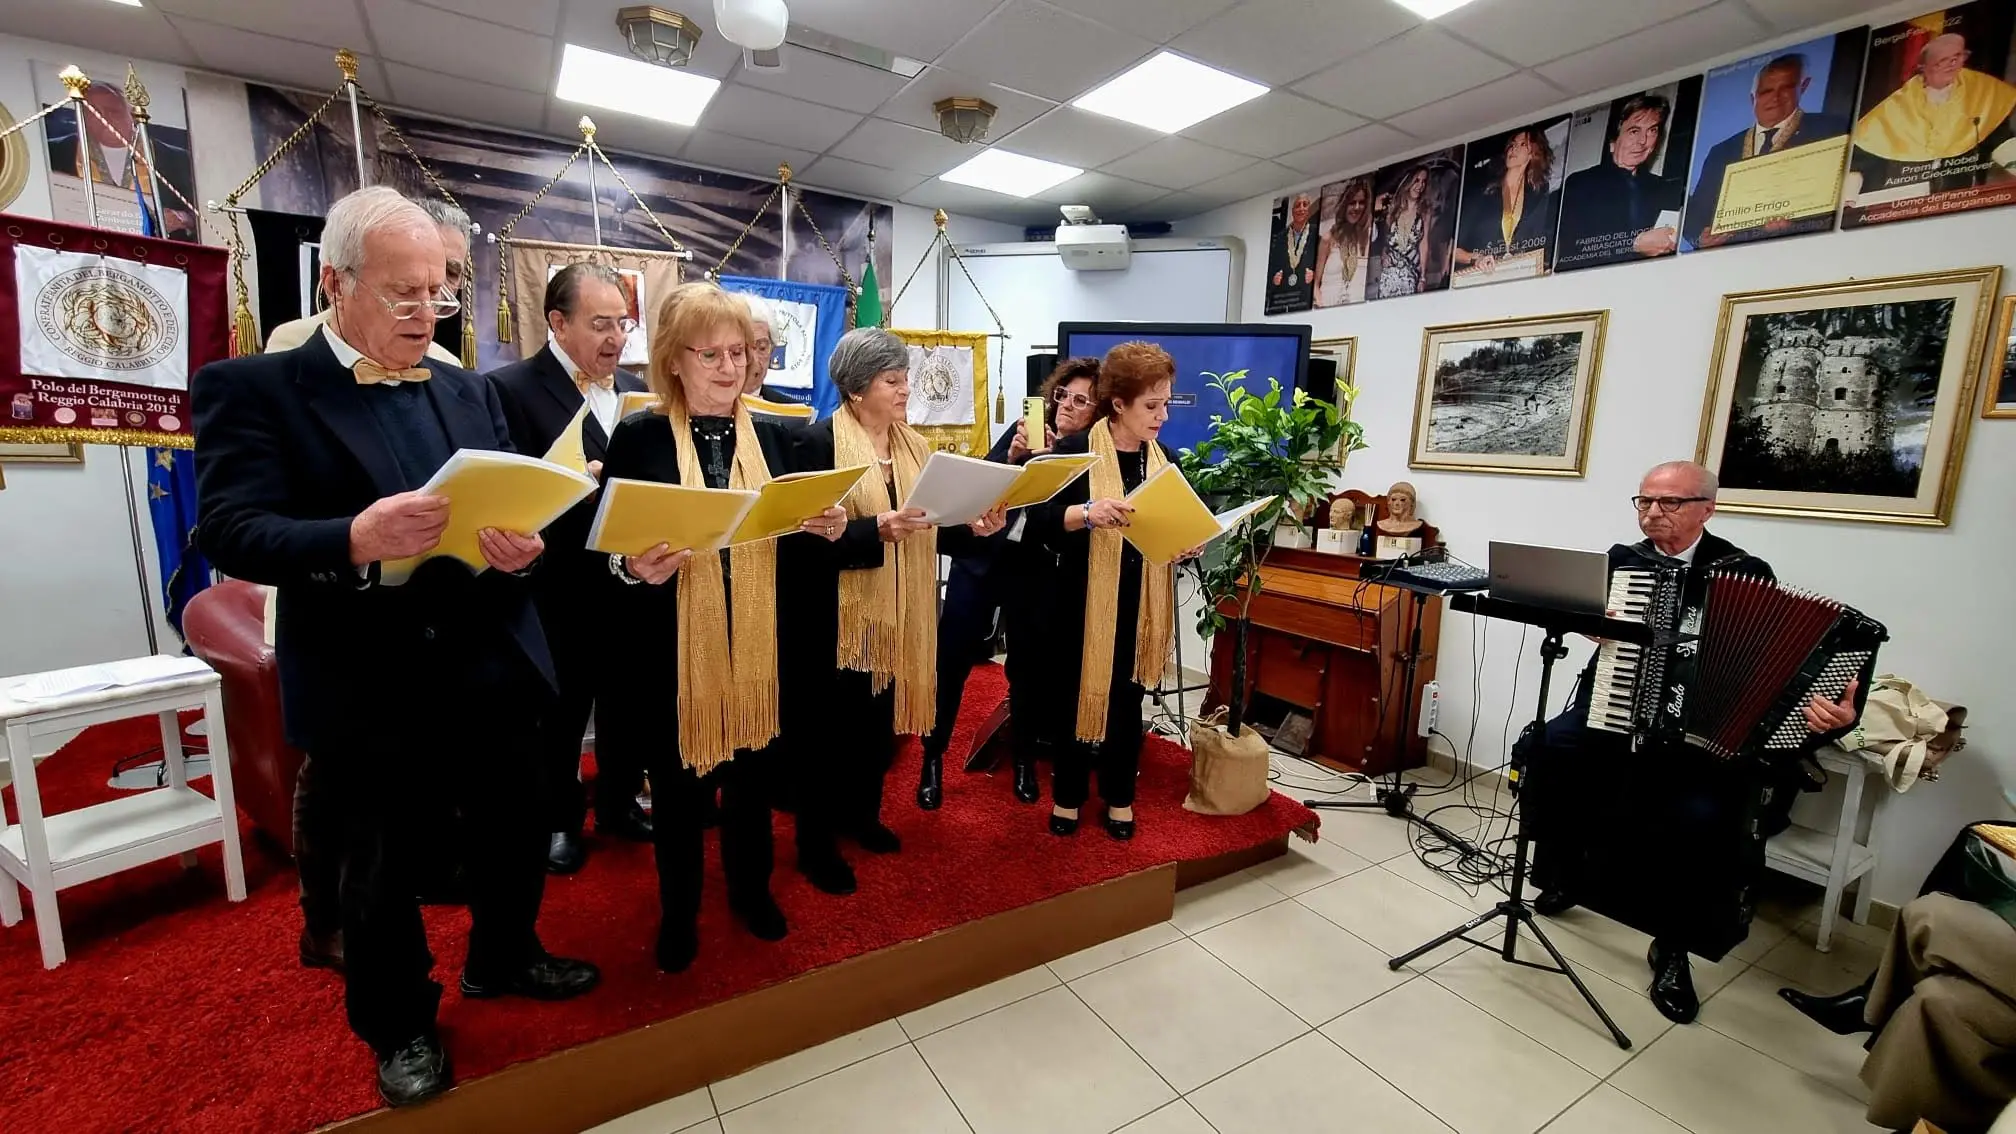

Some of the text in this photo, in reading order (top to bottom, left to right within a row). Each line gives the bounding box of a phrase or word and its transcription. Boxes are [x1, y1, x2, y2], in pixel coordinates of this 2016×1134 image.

[1944, 153, 1979, 167] Nobel
[1884, 175, 1918, 186] Aaron
[1716, 199, 1791, 219] Emilio Errigo
[1858, 193, 2012, 222] Accademia del Bergamotto
[1891, 197, 1927, 209] Uomo
[1521, 236, 1546, 249] 2009
[1575, 233, 1612, 246] FABRIZIO
[1613, 230, 1629, 240] DEL
[1581, 238, 1634, 253] AMBASCIATO
[1559, 251, 1598, 263] ACCADEMIA
[73, 269, 97, 282] DEL
[98, 269, 168, 313] BERGAMOTTO
[166, 318, 176, 337] DEL
[63, 346, 157, 370] REGGIO CALABRIA
[31, 379, 181, 405] Polo del Bergamotto di
[38, 391, 177, 415] Reggio Calabria 2015
[1667, 606, 1699, 718] Paolo Sani
